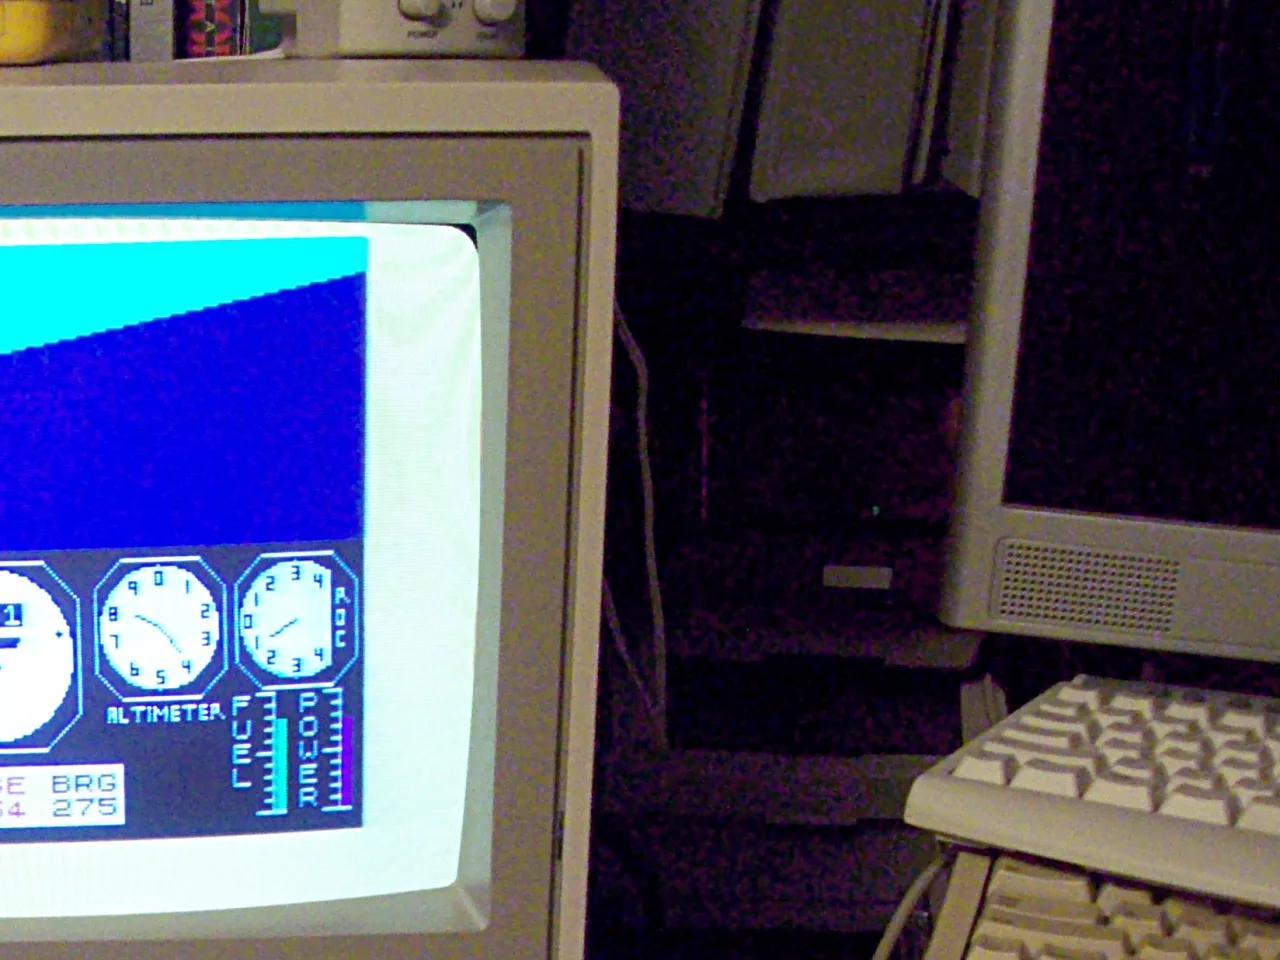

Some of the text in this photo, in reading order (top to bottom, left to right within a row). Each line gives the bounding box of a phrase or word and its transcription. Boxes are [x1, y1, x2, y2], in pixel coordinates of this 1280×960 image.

[154, 571, 164, 586] 0
[291, 566, 300, 580] 3
[128, 581, 138, 595] 9
[184, 579, 190, 593] 1
[265, 576, 275, 590] 2
[313, 574, 322, 589] 4
[254, 592, 260, 606] 1
[109, 607, 118, 622] 8
[201, 603, 211, 617] 2
[244, 615, 252, 629] 0
[111, 635, 119, 649] 7
[202, 631, 211, 646] 3
[255, 635, 261, 650] 1
[267, 651, 276, 665] 2
[314, 647, 324, 661] 4
[130, 662, 140, 676] 6
[182, 660, 192, 675] 4
[292, 658, 301, 672] 3
[156, 670, 166, 684] 5
[106, 704, 226, 724] ALTIMETER
[232, 695, 251, 788] FUEL
[297, 694, 319, 807] POWER
[53, 775, 117, 793] BRG
[53, 798, 118, 816] 275
